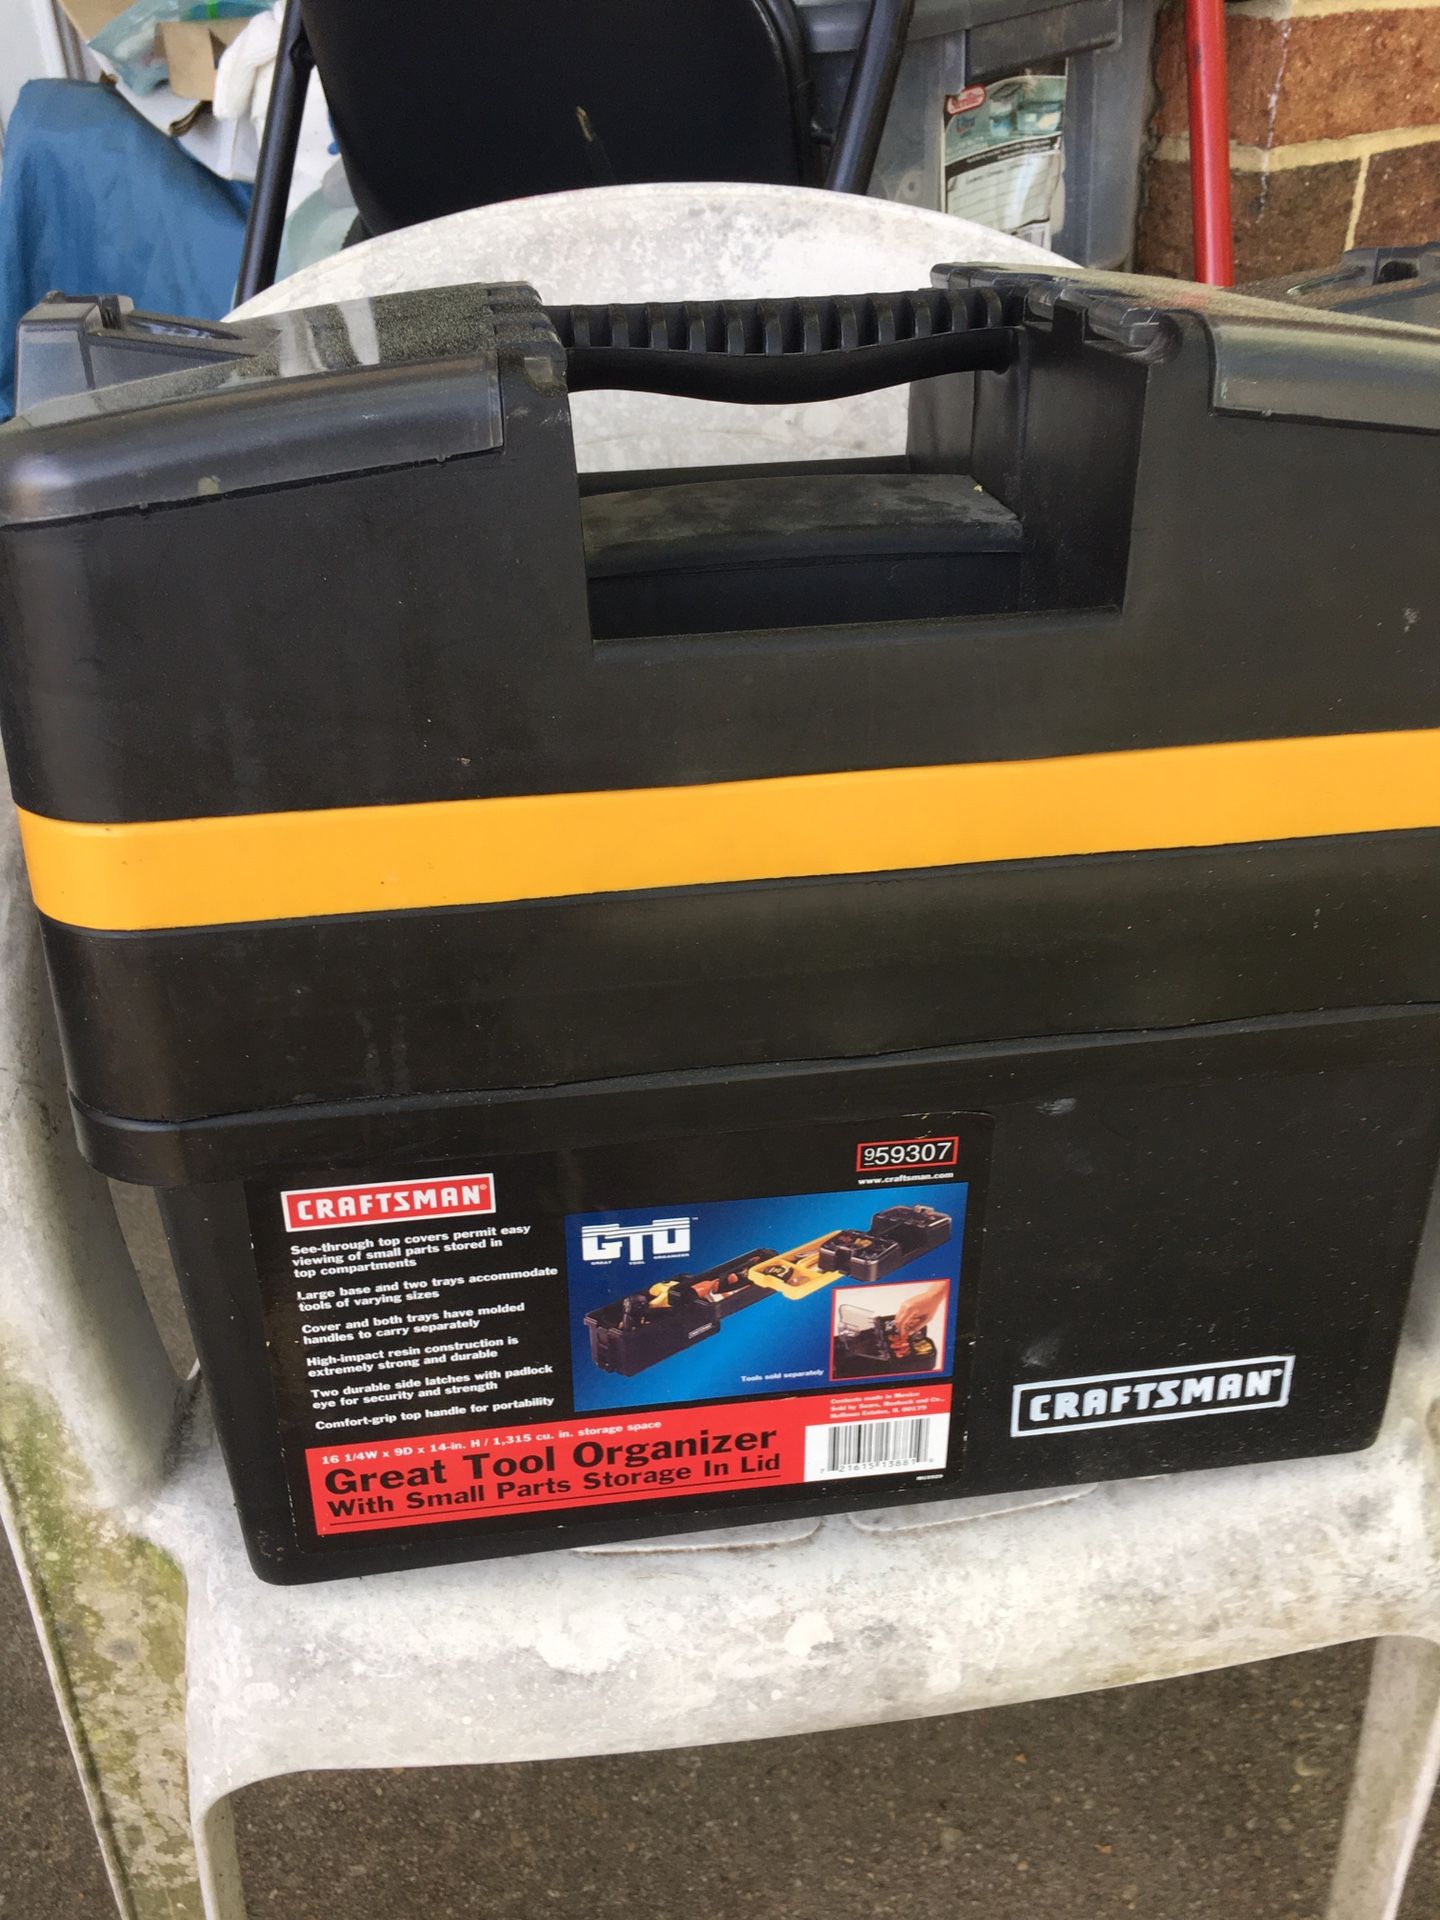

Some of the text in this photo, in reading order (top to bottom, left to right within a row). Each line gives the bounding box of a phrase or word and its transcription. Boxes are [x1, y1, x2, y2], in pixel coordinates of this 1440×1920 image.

[864, 1142, 952, 1166] 959307
[858, 1172, 954, 1185] www.craftsman.com
[297, 1184, 480, 1221] CRAFTSMAN
[290, 1225, 531, 1255] See-through top covers permit easy
[292, 1238, 503, 1267] viewing of small parts stored in
[582, 1217, 690, 1261] GTO
[294, 1258, 417, 1278] top compartments
[297, 1267, 558, 1300] Large base and two trays accommodate
[298, 1290, 439, 1312] tools of varying sizes
[301, 1302, 525, 1334] Cover and both trays have molded
[303, 1319, 480, 1345] handles to carry separately
[306, 1336, 519, 1366] High-impact resin construction is
[308, 1349, 498, 1377] extremely strong and durable
[310, 1364, 553, 1398] Two durable side latches with padlock
[312, 1382, 498, 1410] eye for security and strength
[1029, 1371, 1271, 1421] CRAFTSMAN
[315, 1397, 554, 1430] Comfort-grip top handle for portability
[322, 1456, 339, 1465] 16
[345, 1451, 378, 1462] 1/4W
[394, 1447, 413, 1456] 9D
[430, 1442, 466, 1452] 14-in.
[471, 1440, 480, 1448] H
[493, 1434, 531, 1446] 1,315
[536, 1433, 554, 1441] cu.
[558, 1430, 574, 1438] in.
[578, 1424, 623, 1437] storage
[627, 1421, 662, 1432] space
[325, 1429, 777, 1494] Great Tool Organizer
[327, 1453, 780, 1517] With Small Parts Storage In Lid
